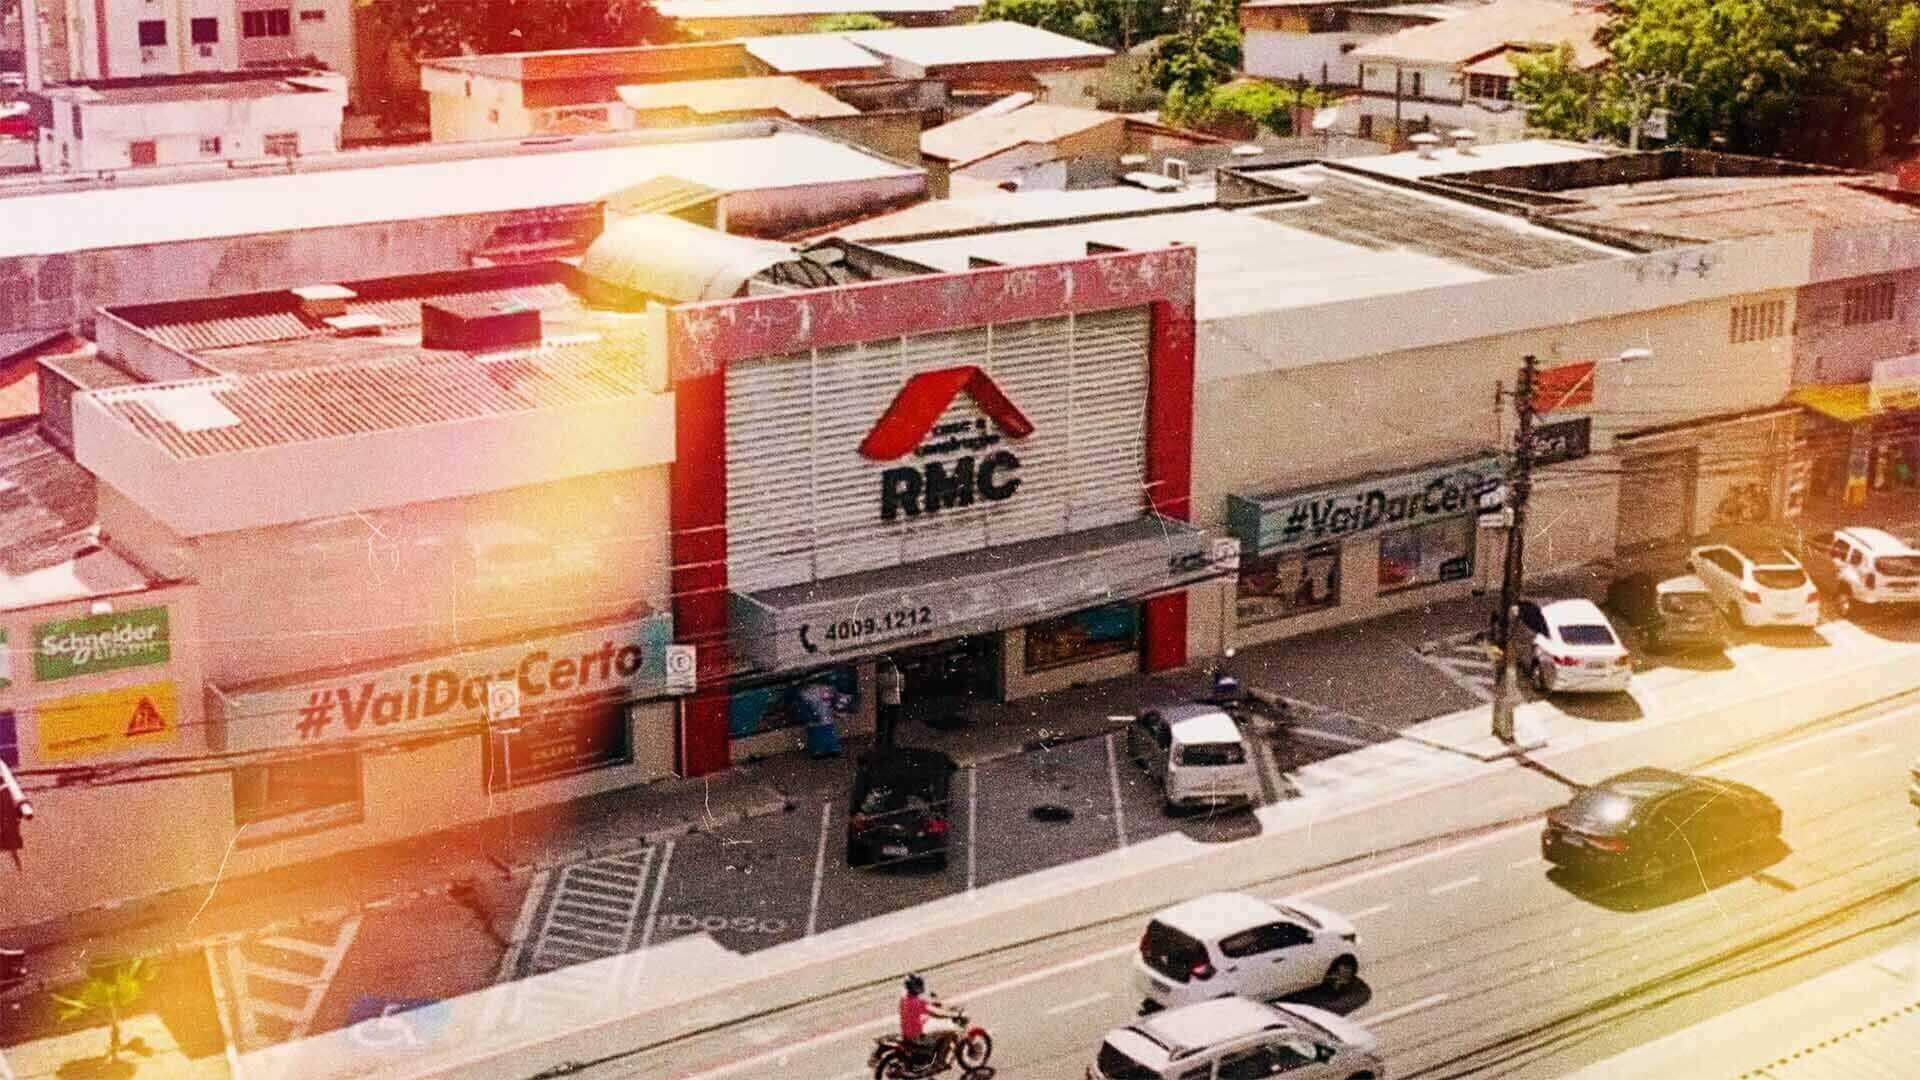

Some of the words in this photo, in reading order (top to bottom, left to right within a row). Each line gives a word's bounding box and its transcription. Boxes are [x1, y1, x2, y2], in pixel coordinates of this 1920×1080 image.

[881, 451, 1021, 520] RMC
[825, 606, 932, 640] 4009.1212
[43, 624, 158, 665] Schneider
[660, 911, 786, 933] IDOSO
